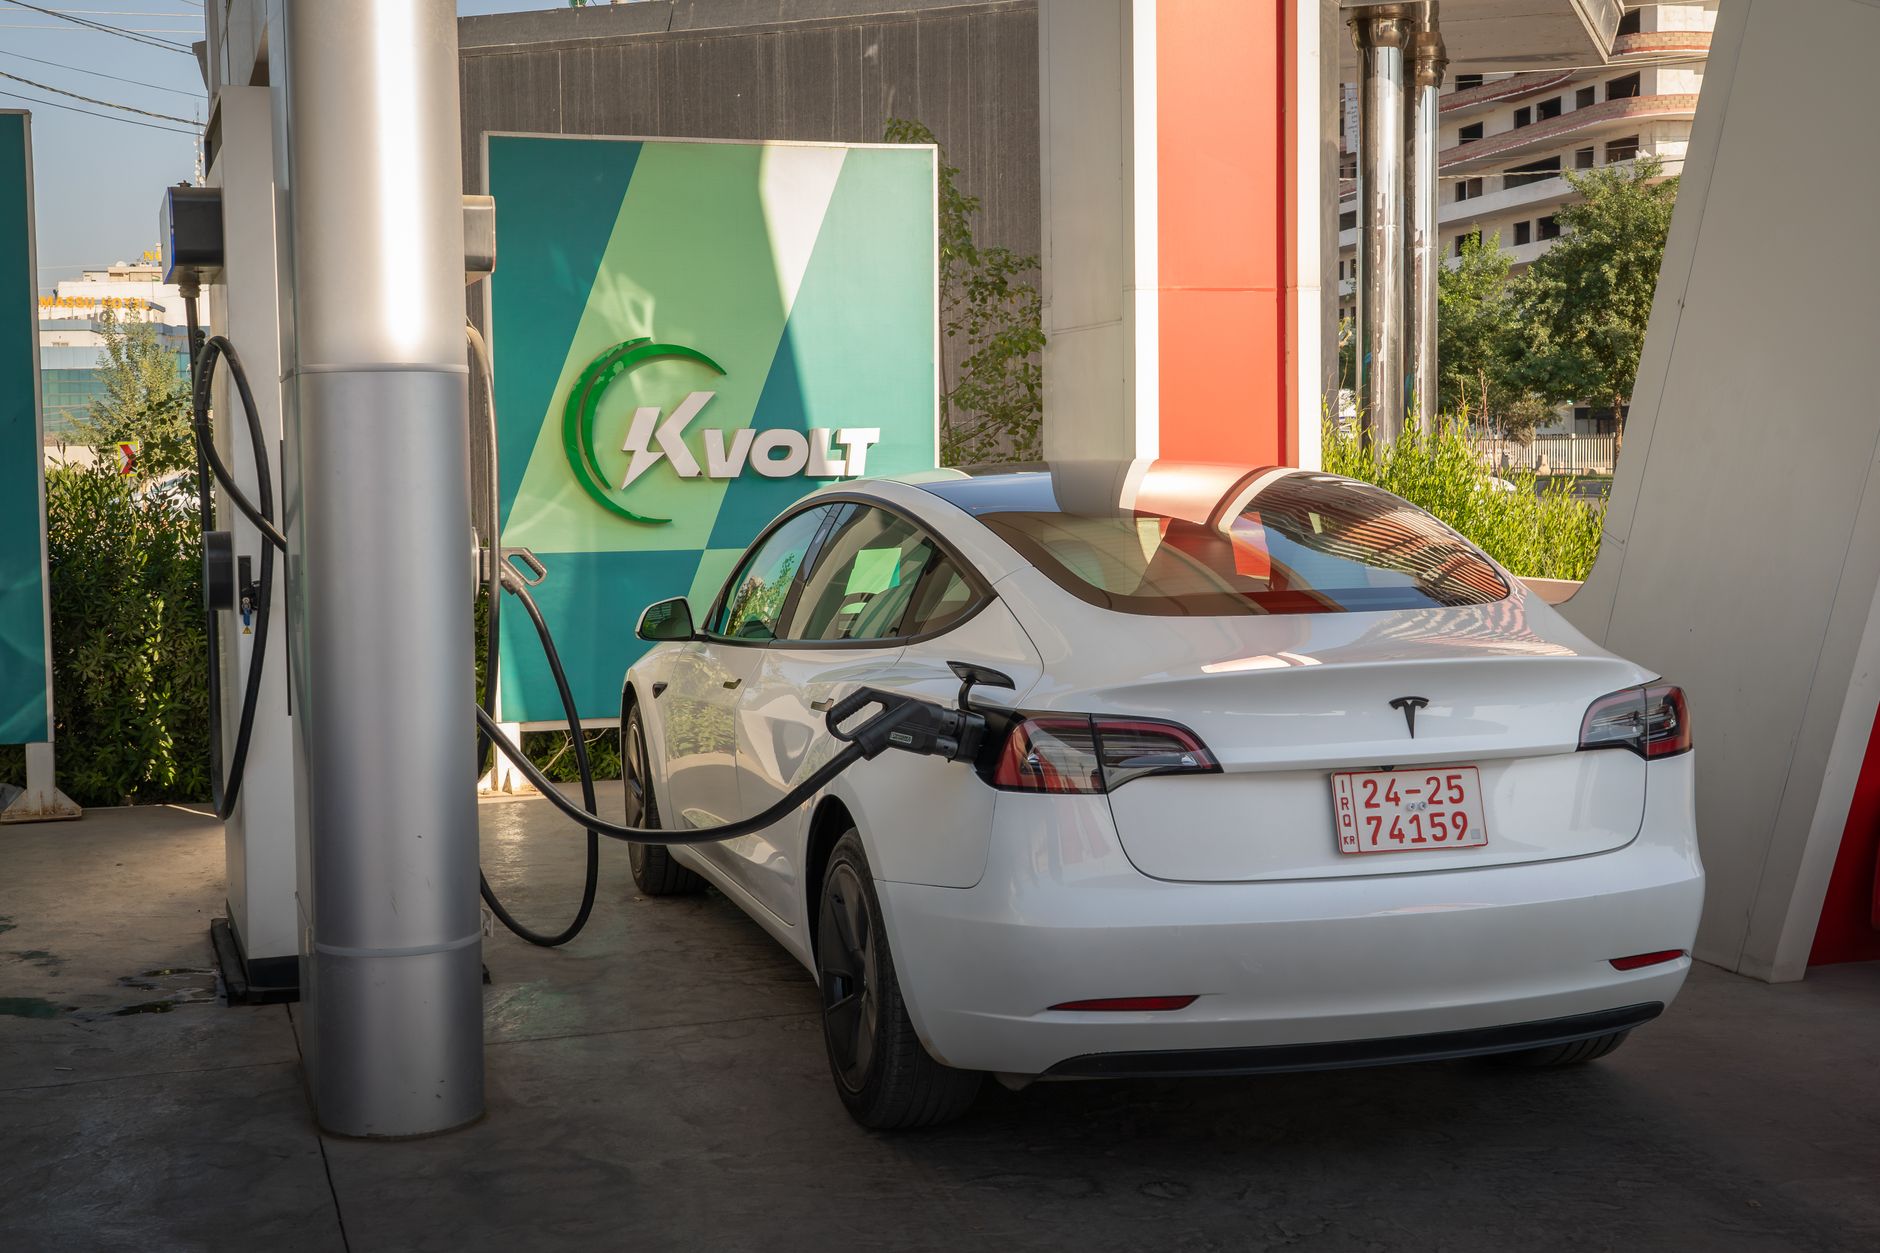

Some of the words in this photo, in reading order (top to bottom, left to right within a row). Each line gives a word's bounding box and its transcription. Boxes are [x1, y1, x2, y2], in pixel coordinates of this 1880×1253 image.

[40, 296, 95, 309] MASSU
[1341, 780, 1352, 827] IRQ
[1362, 775, 1464, 808] 24-25
[1343, 836, 1355, 845] KR
[1366, 811, 1468, 845] 74159
